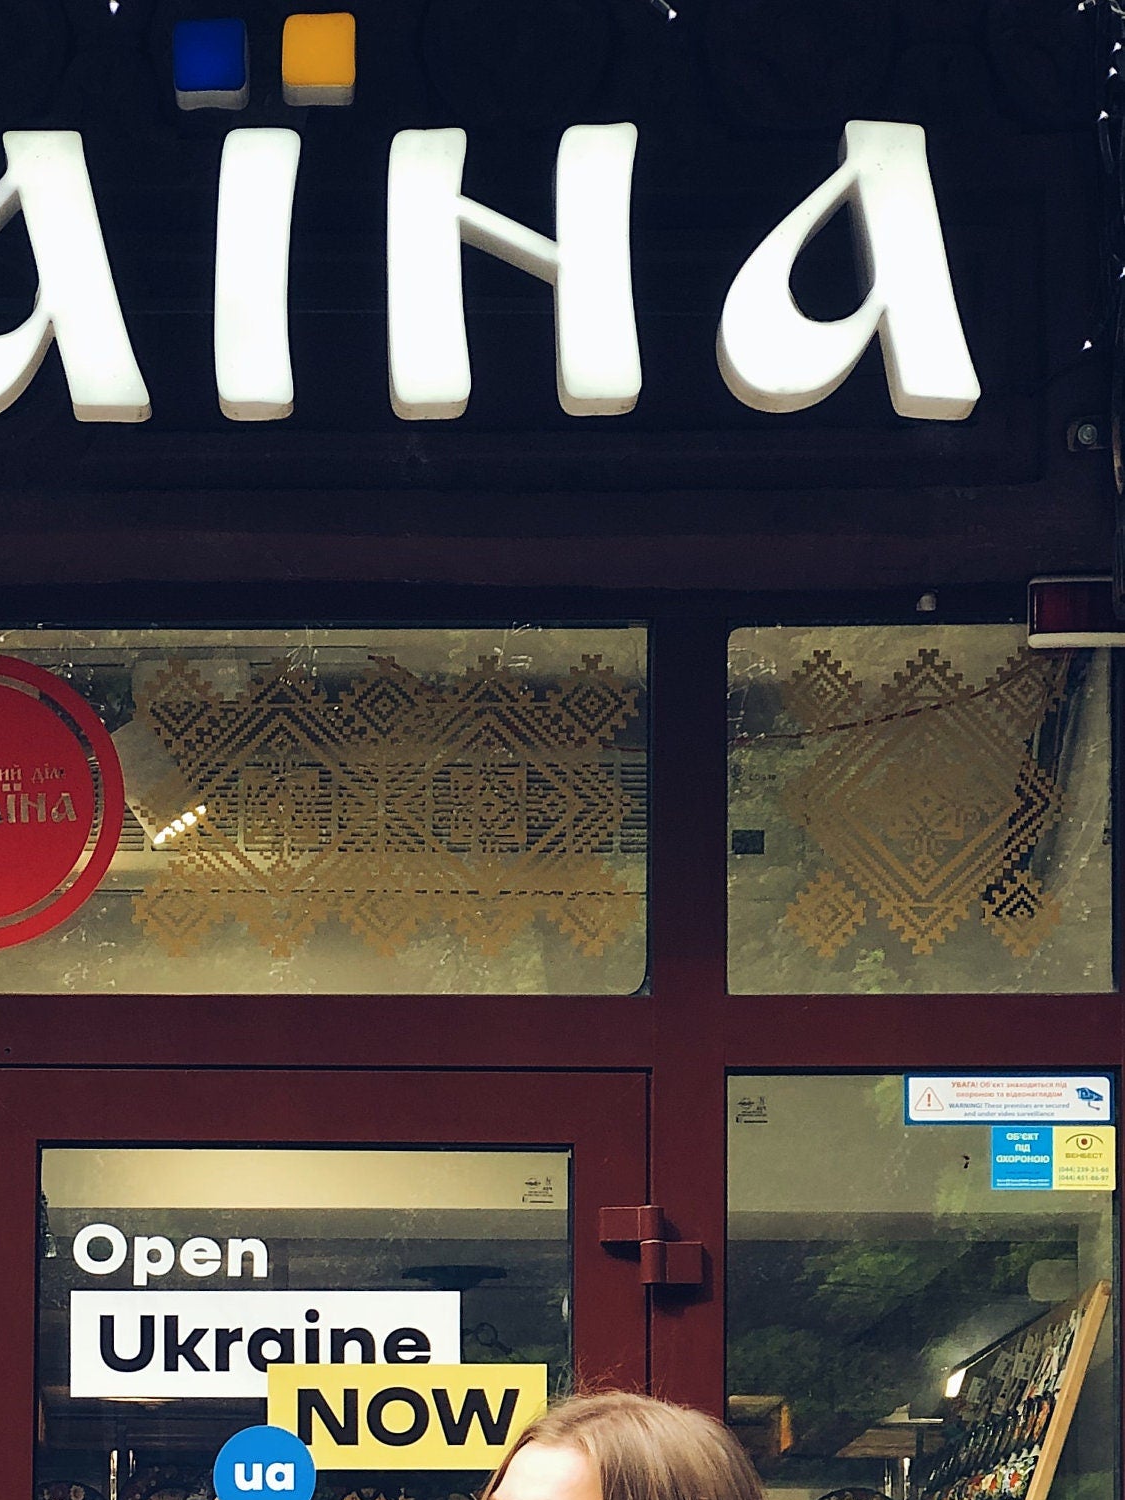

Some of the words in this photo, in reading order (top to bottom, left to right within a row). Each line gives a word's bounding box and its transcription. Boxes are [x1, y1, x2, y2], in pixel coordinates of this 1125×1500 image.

[73, 1223, 270, 1286] Open
[99, 1308, 432, 1373] Ukraine
[296, 1386, 520, 1447] NOW
[233, 1459, 296, 1492] ua
